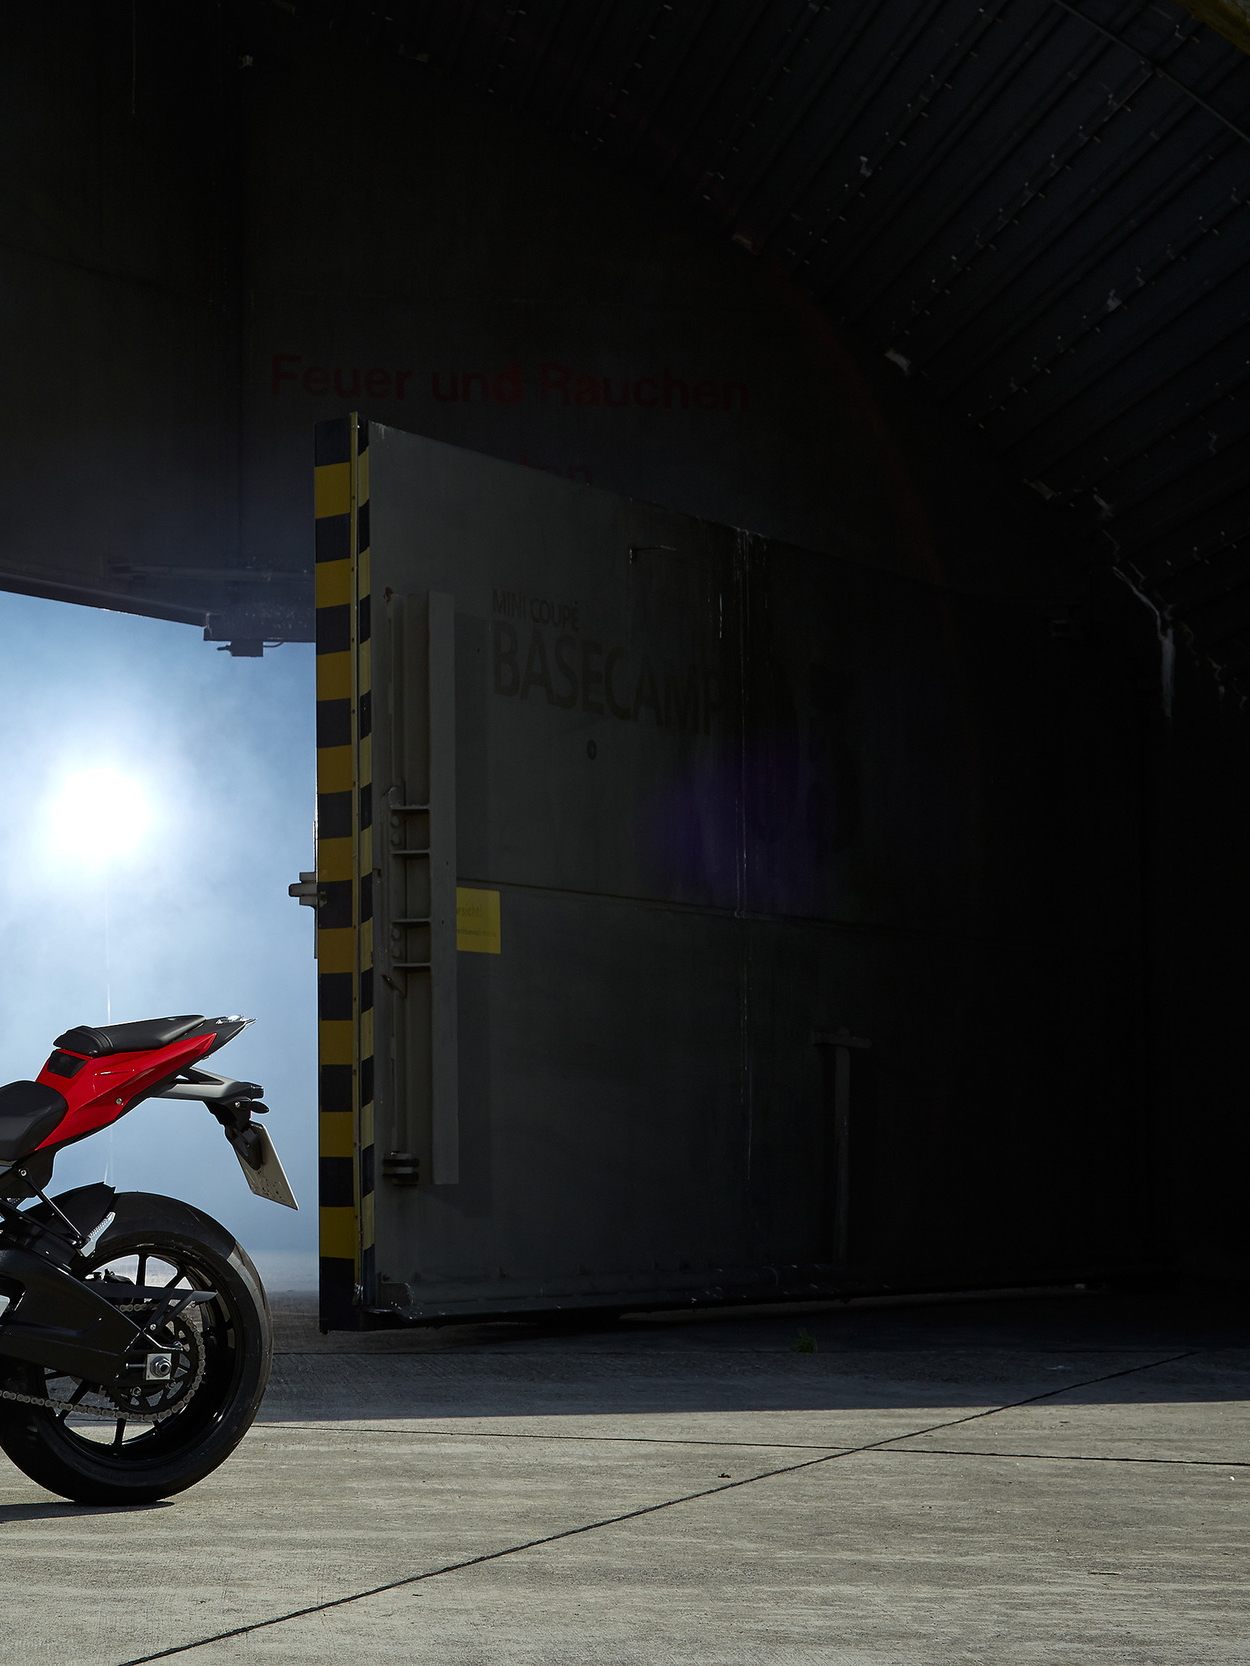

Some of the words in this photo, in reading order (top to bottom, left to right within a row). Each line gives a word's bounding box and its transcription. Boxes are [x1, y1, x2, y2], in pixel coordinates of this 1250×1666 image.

[270, 353, 412, 400] Feuer
[431, 361, 525, 405] und
[539, 362, 751, 412] Rauchen
[492, 588, 527, 619] MINI
[492, 619, 724, 737] BASECAMP
